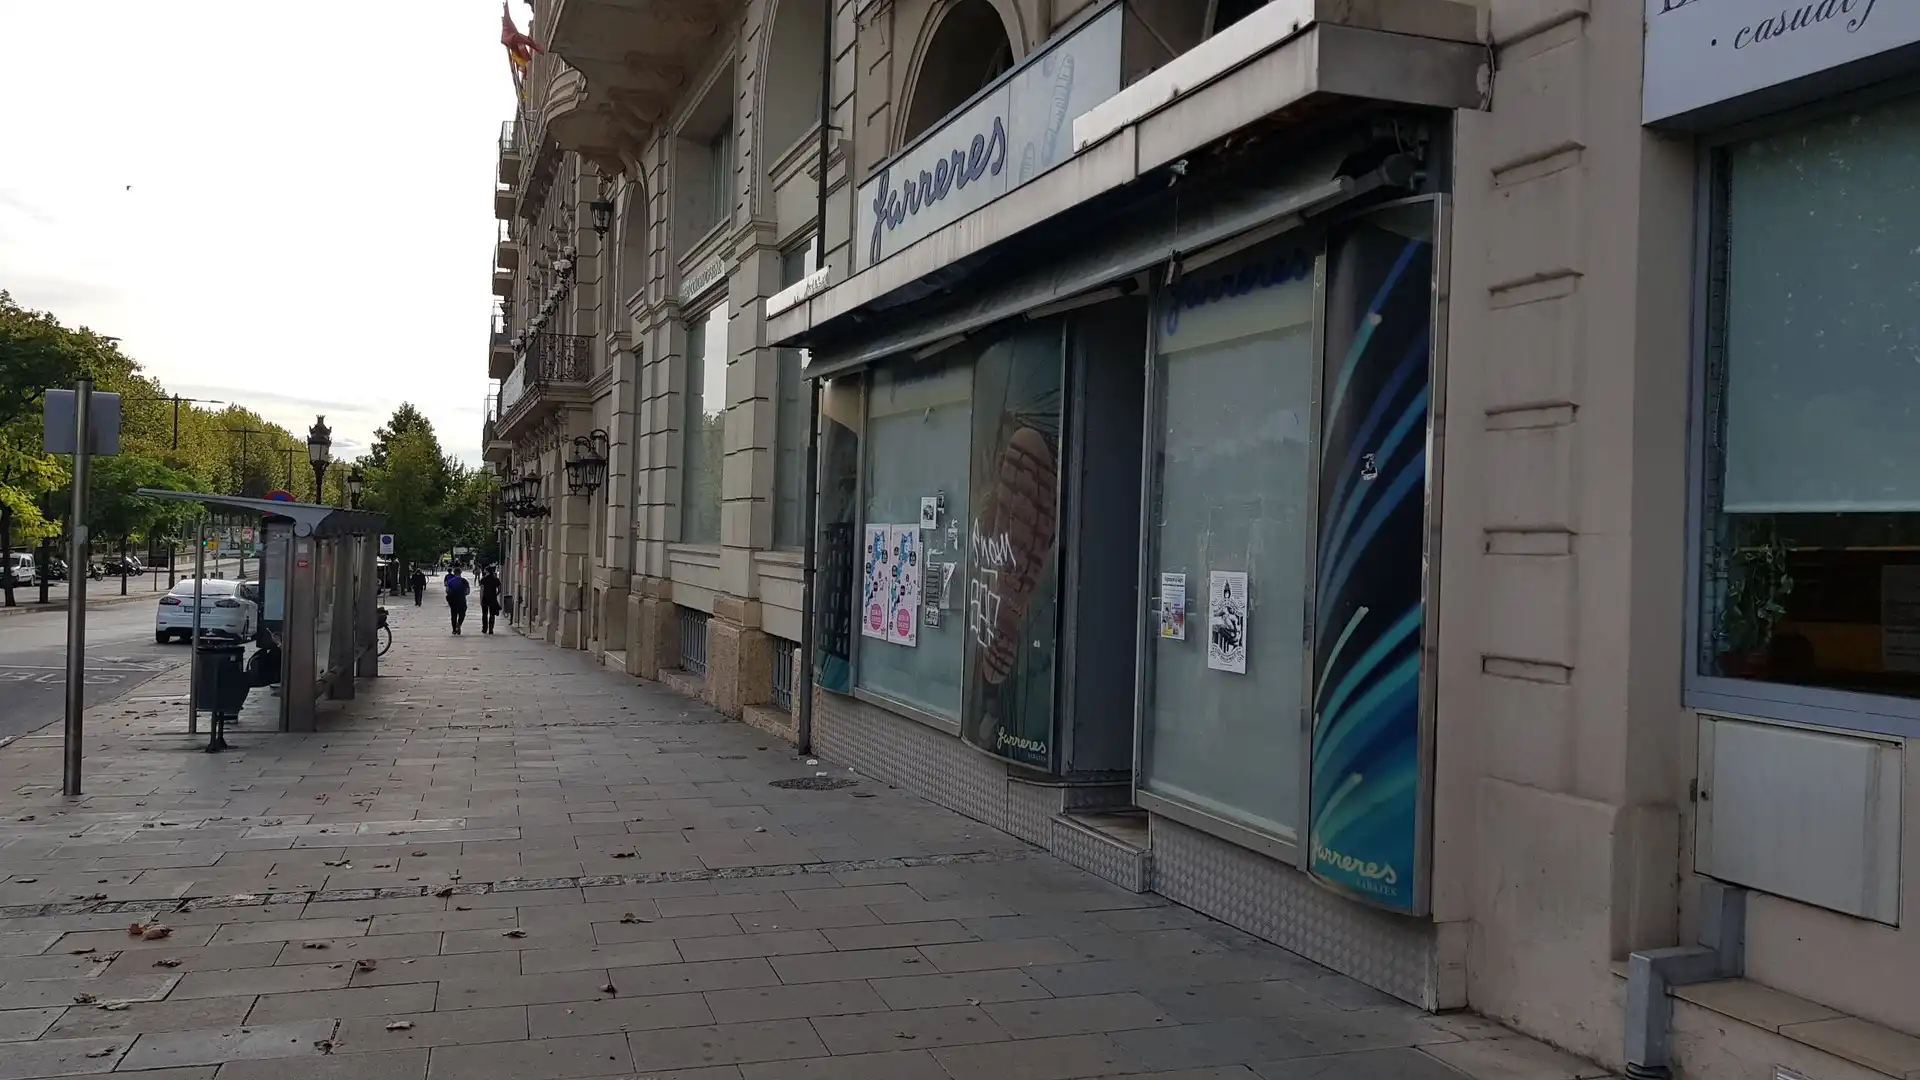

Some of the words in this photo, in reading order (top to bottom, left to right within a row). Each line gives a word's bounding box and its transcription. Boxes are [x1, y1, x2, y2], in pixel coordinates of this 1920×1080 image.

[869, 116, 1006, 265] farreres
[996, 725, 1047, 755] farreres
[1311, 834, 1398, 884] farreres
